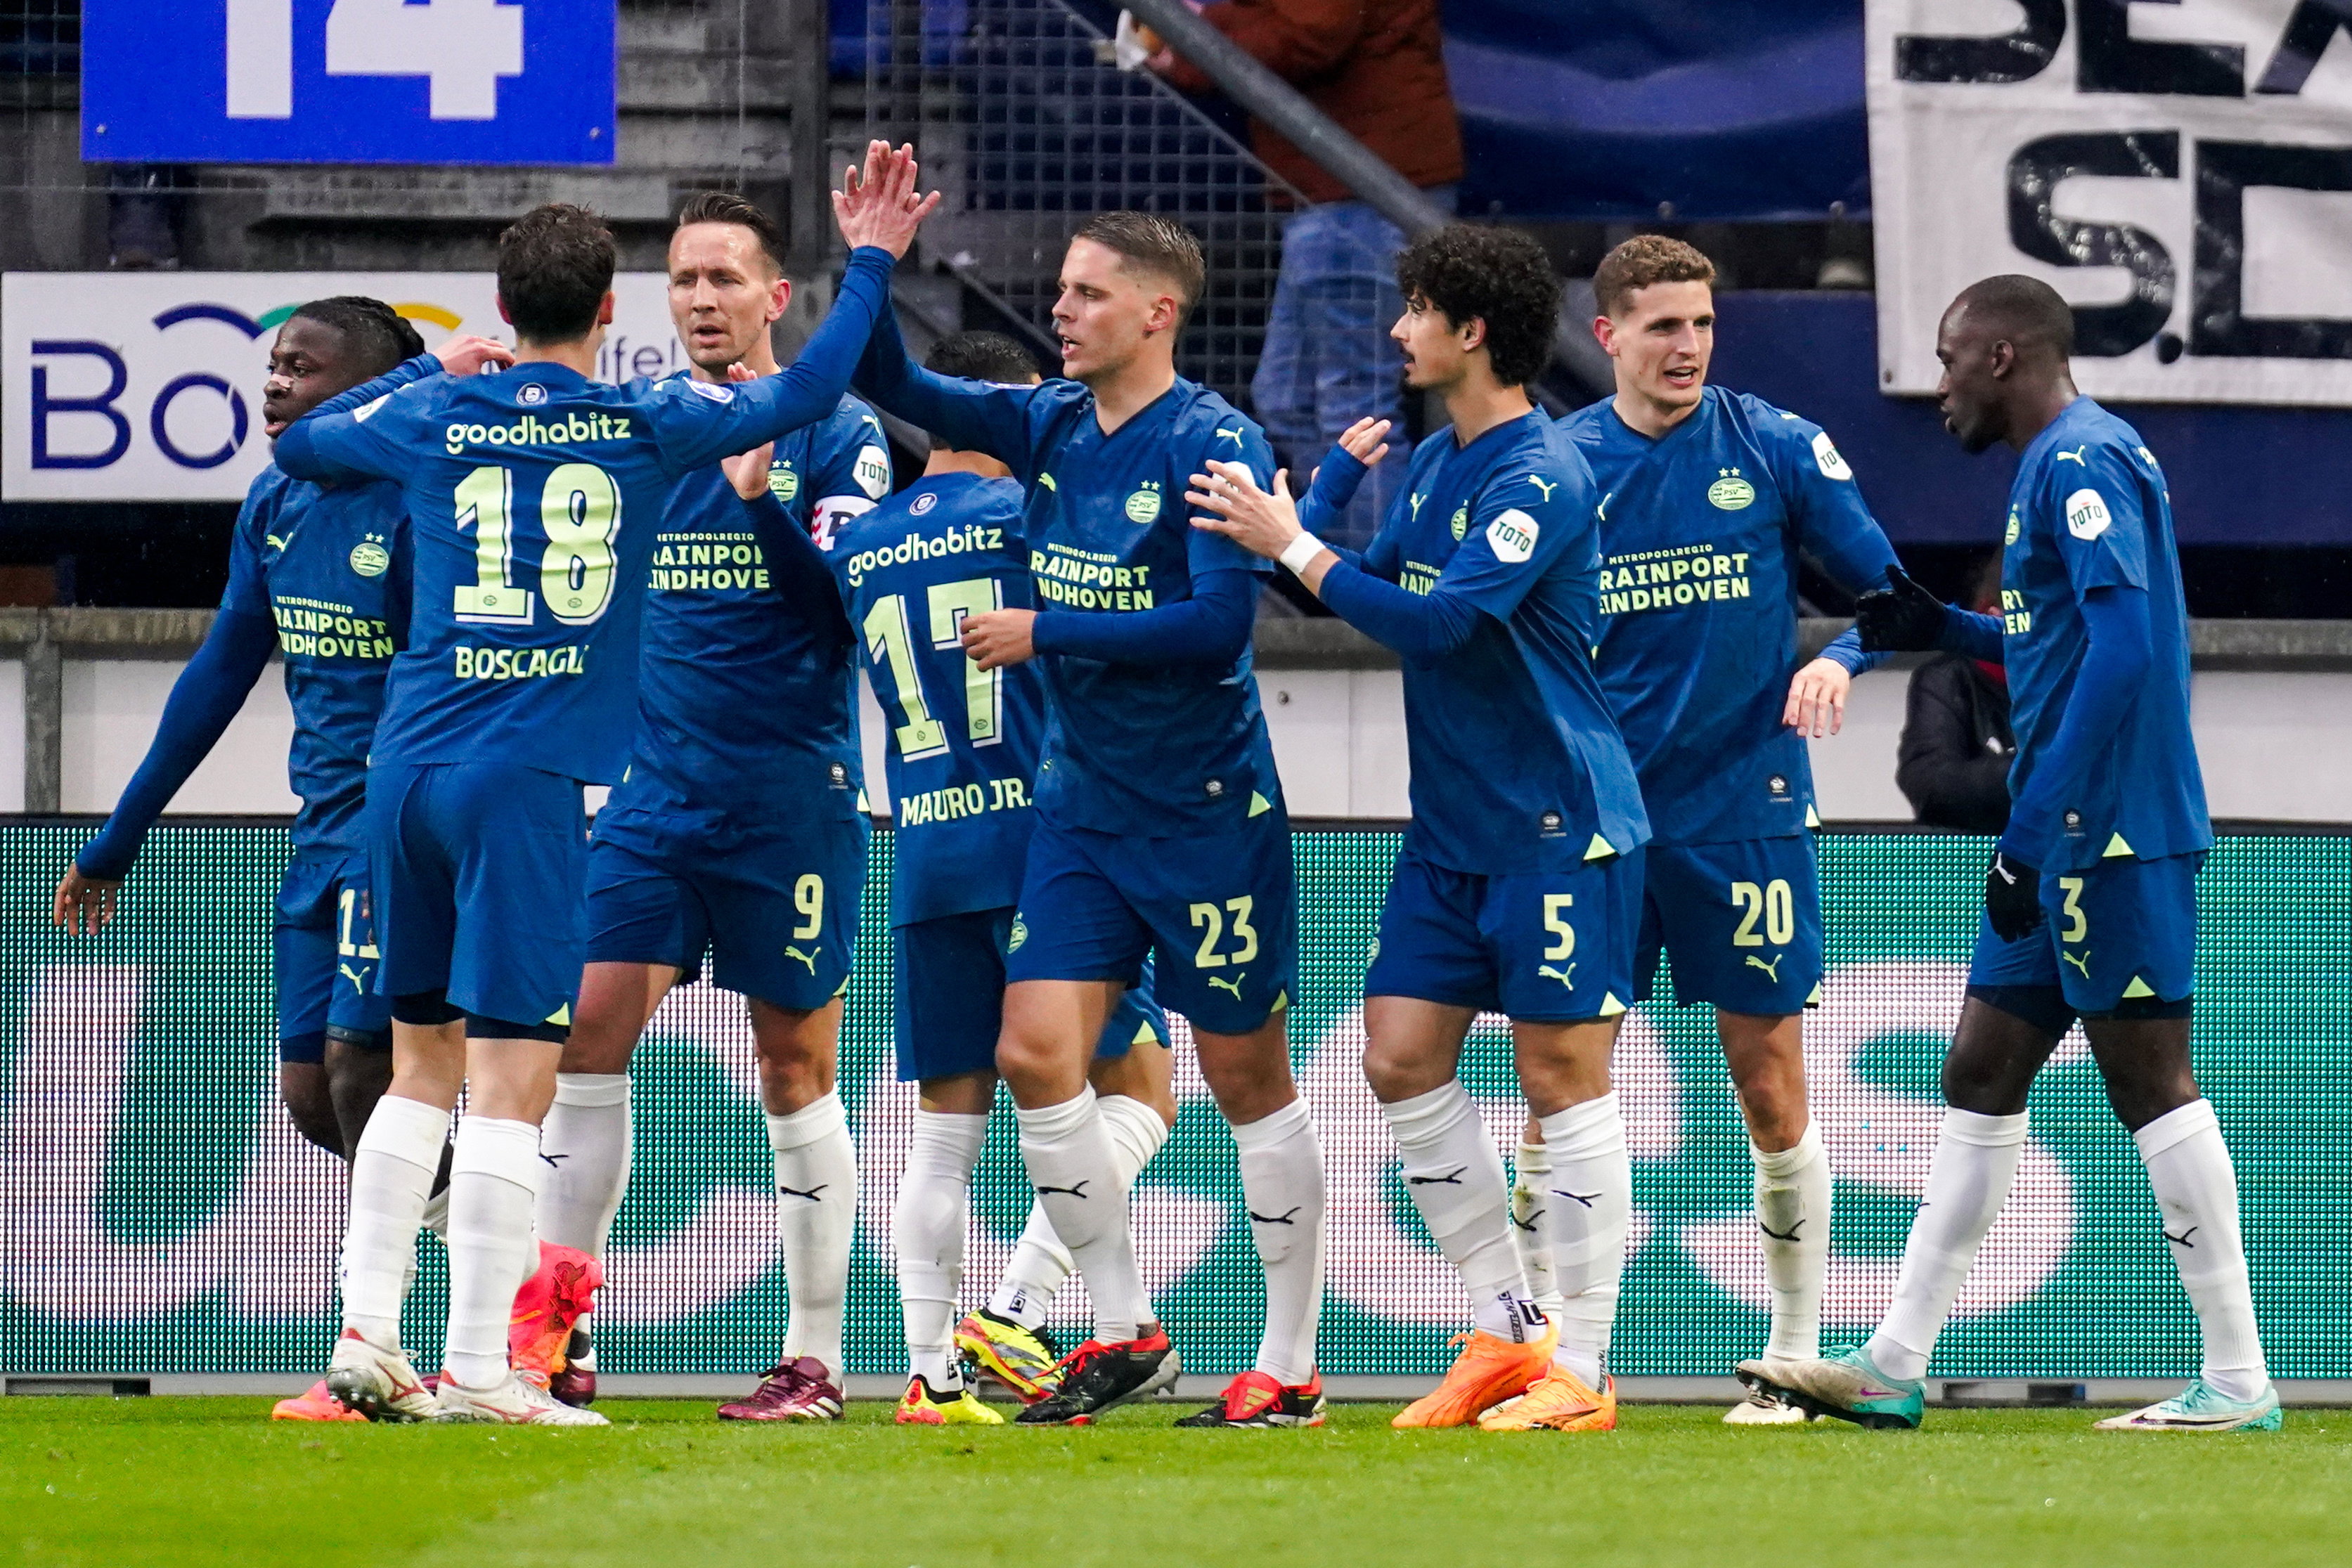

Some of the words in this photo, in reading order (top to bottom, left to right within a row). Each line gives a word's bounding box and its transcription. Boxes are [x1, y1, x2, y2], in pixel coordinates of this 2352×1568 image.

[446, 412, 631, 455] goodhabitz
[860, 461, 888, 485] TOTO
[1495, 521, 1530, 552] TOTO
[2070, 505, 2102, 529] TOTO
[453, 463, 623, 626] 18
[848, 524, 1004, 588] goodhabitz
[1609, 544, 1713, 564] METROPOOLREGIO
[648, 569, 770, 590] INDHOVE
[1030, 550, 1150, 588] RAINPORT
[1599, 553, 1749, 590] RAINPORT
[1037, 576, 1154, 610] NDHOVEN
[2003, 611, 2031, 635] EN
[862, 577, 1003, 763] 17
[900, 784, 984, 828] MAURO
[989, 777, 1033, 811] JR.
[793, 874, 824, 940] 9
[1544, 894, 1575, 960] 5
[1731, 879, 1794, 946] 20
[2059, 877, 2087, 942] 3
[1189, 895, 1258, 968] 23
